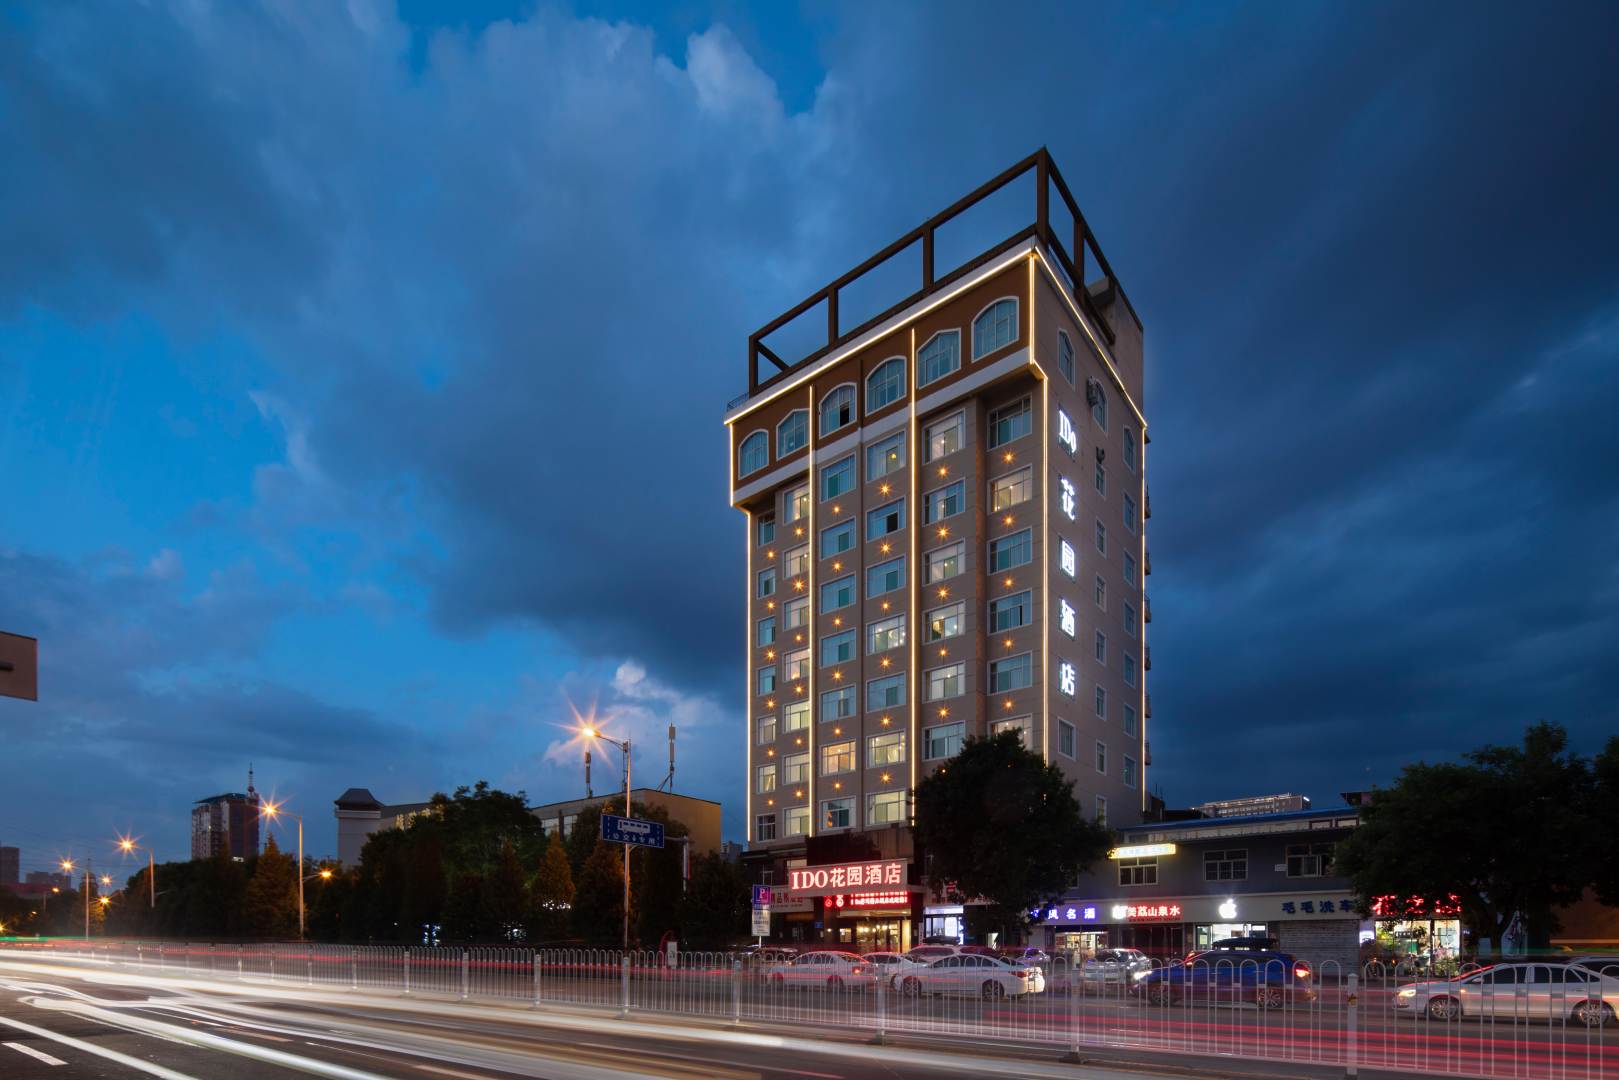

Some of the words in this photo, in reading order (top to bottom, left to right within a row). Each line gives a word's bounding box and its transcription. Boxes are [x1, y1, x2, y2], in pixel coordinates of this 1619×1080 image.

[791, 862, 902, 890] IDO花园酒店
[1282, 899, 1355, 914] 毛毛洗车
